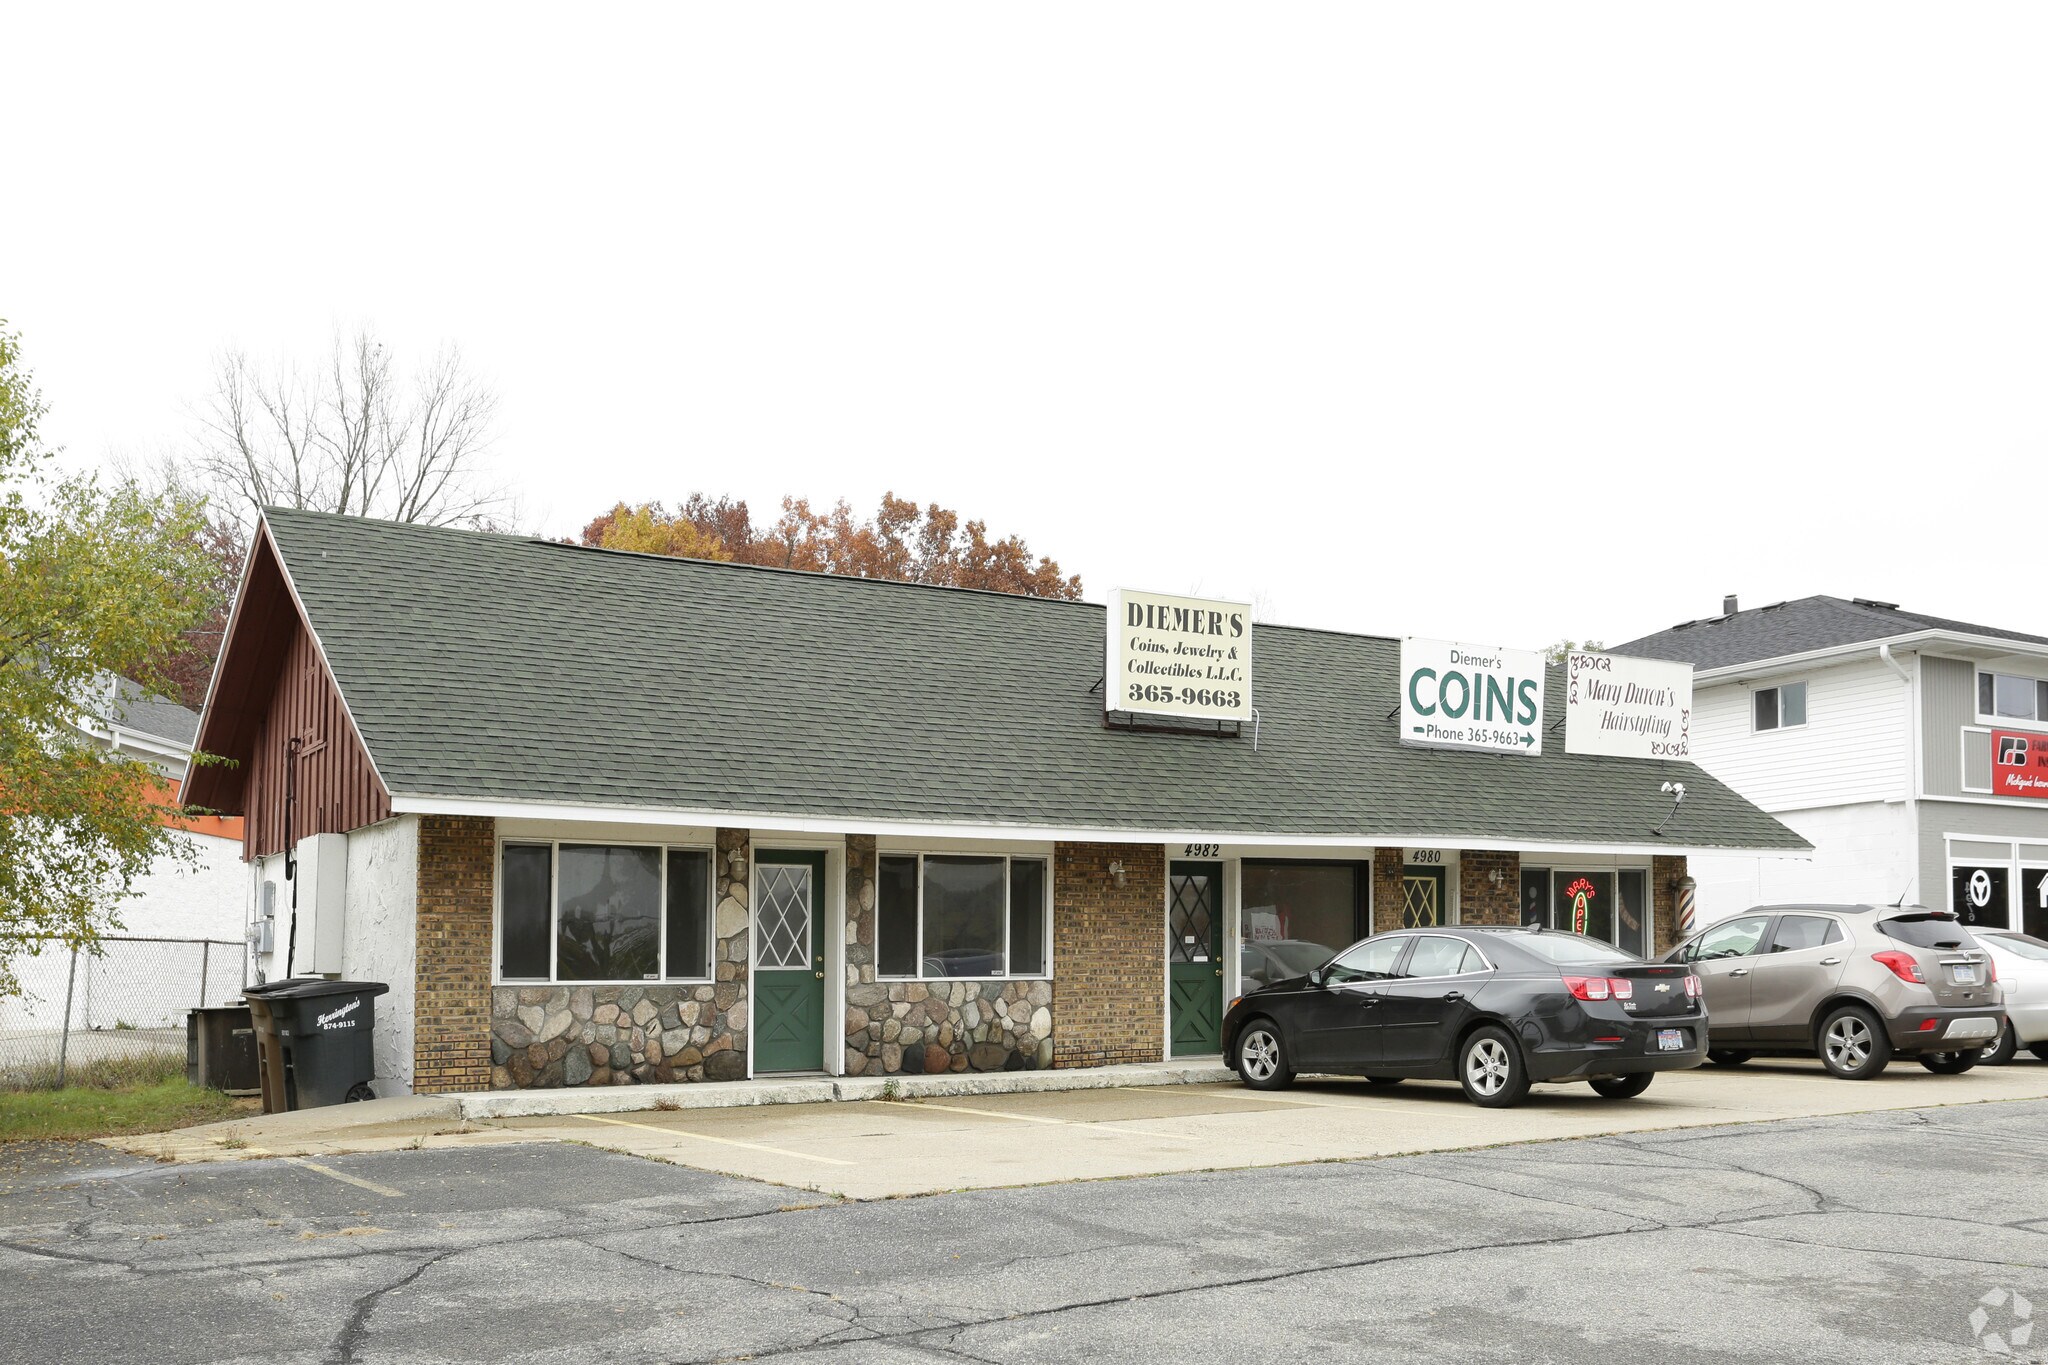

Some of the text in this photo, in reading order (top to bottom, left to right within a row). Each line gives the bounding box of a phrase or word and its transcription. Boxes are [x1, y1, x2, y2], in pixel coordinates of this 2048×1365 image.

[1127, 602, 1243, 638] DIEMER'S
[1130, 636, 1239, 662] Coins, Jewelry &
[1450, 650, 1502, 669] Diemer's
[1127, 658, 1243, 681] Collectibles L.L.C.
[1128, 683, 1242, 708] 365-9663
[1408, 667, 1537, 726] COINS
[1584, 678, 1676, 707] Mary Duron's
[1426, 724, 1519, 746] Phone 365-9663
[1600, 710, 1672, 739] Hairstyling
[1184, 843, 1220, 857] 4982
[1412, 850, 1441, 863] 4980
[1566, 878, 1596, 899] MARY'S
[1576, 896, 1585, 936] OPE
[323, 1020, 356, 1030] 874-9115
